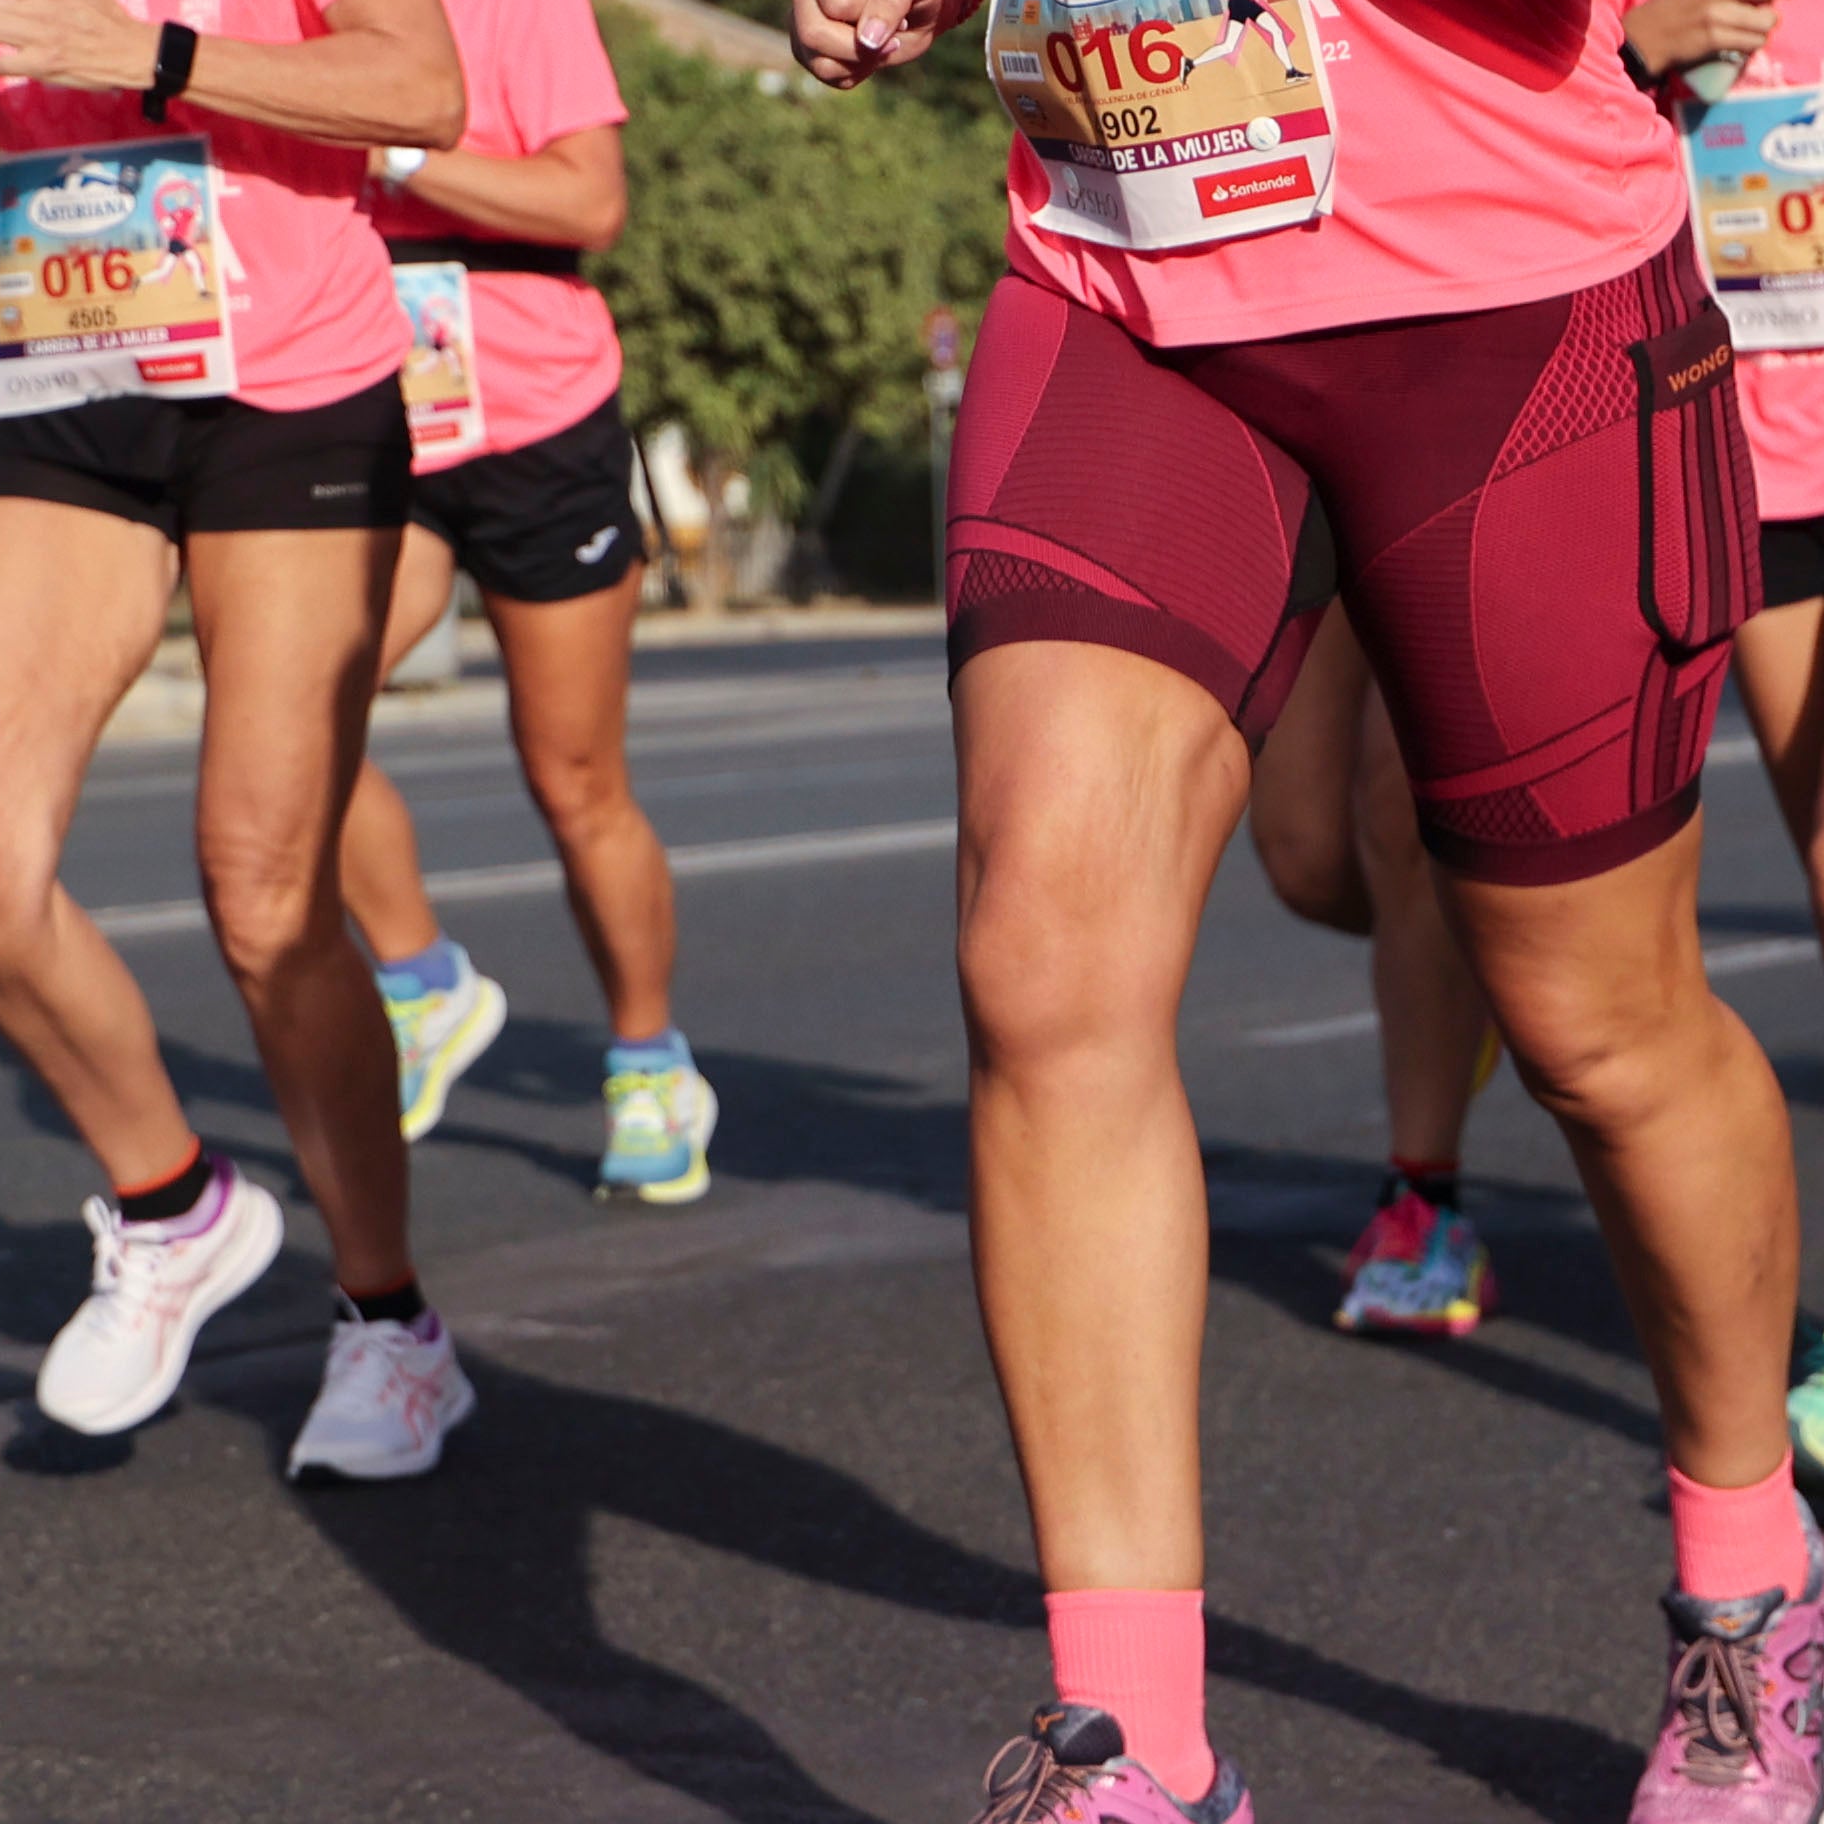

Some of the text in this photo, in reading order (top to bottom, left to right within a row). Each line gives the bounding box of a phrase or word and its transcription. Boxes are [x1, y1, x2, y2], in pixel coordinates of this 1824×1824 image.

[1046, 20, 1186, 93] 016
[1097, 105, 1162, 140] 902
[1112, 148, 1139, 172] DE
[1141, 144, 1170, 167] LA
[1171, 128, 1249, 162] MUJER
[1229, 174, 1296, 199] Santander
[41, 247, 134, 298] 016
[1667, 344, 1731, 392] WONG
